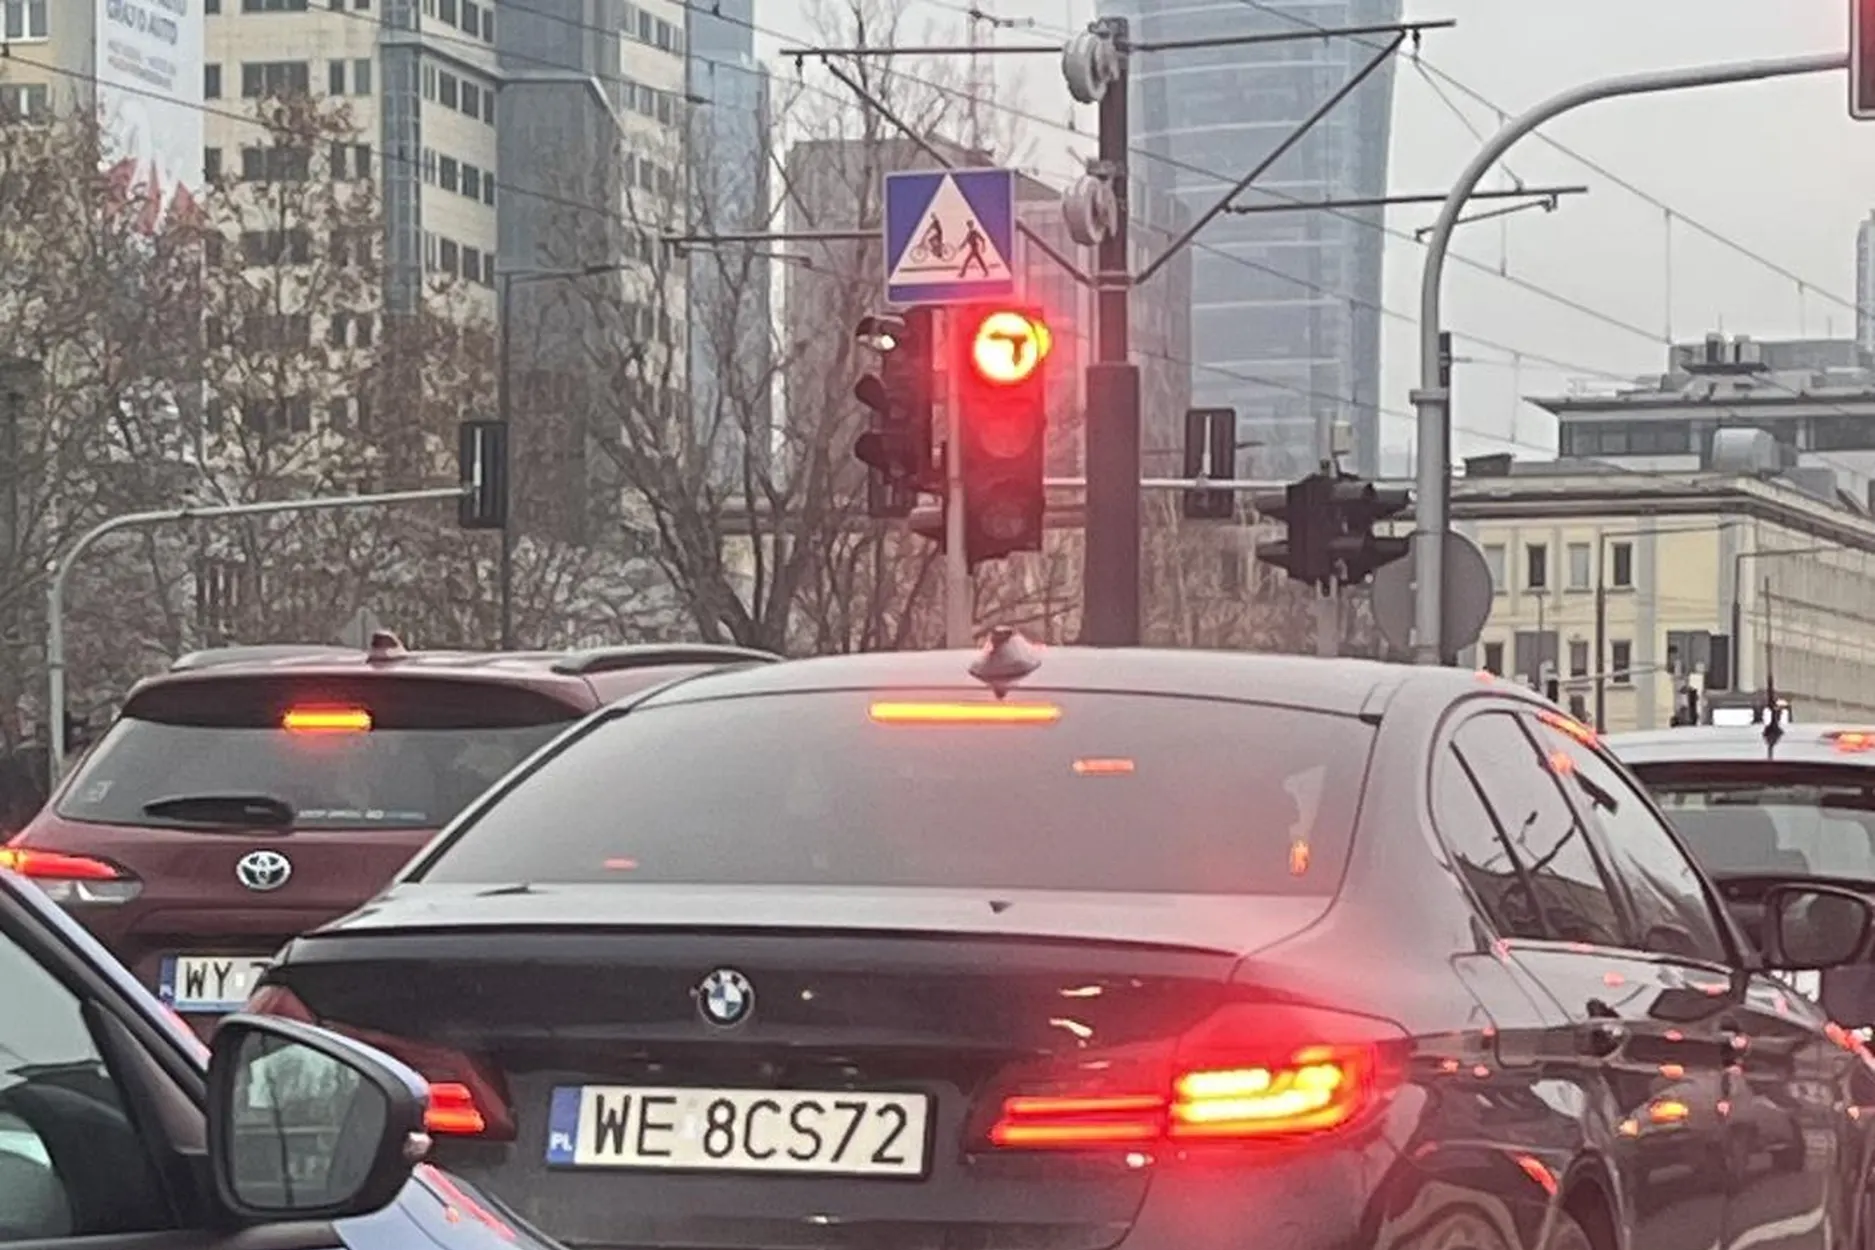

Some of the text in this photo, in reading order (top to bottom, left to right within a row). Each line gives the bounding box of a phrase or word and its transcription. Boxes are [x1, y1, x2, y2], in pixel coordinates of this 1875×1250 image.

[185, 961, 233, 998] WY
[550, 1133, 573, 1151] PL
[595, 1093, 907, 1164] WE 8CS72
